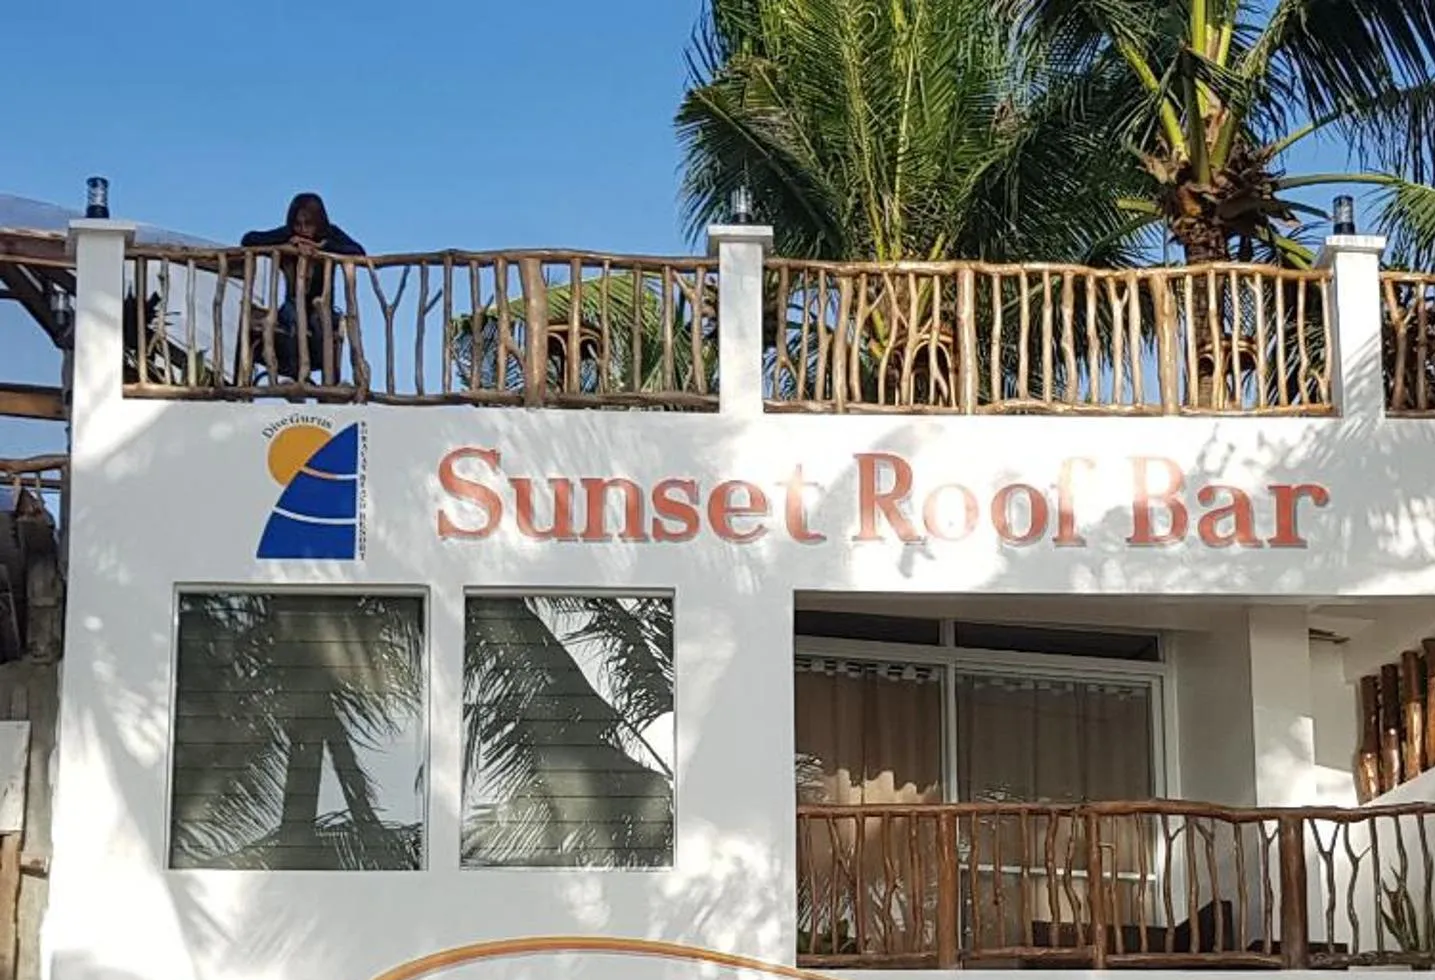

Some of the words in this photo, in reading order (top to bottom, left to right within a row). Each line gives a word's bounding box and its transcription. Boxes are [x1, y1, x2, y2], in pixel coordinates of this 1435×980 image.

[437, 446, 829, 544] Sunset
[850, 452, 1097, 547] Roof
[1125, 455, 1332, 549] Bar
